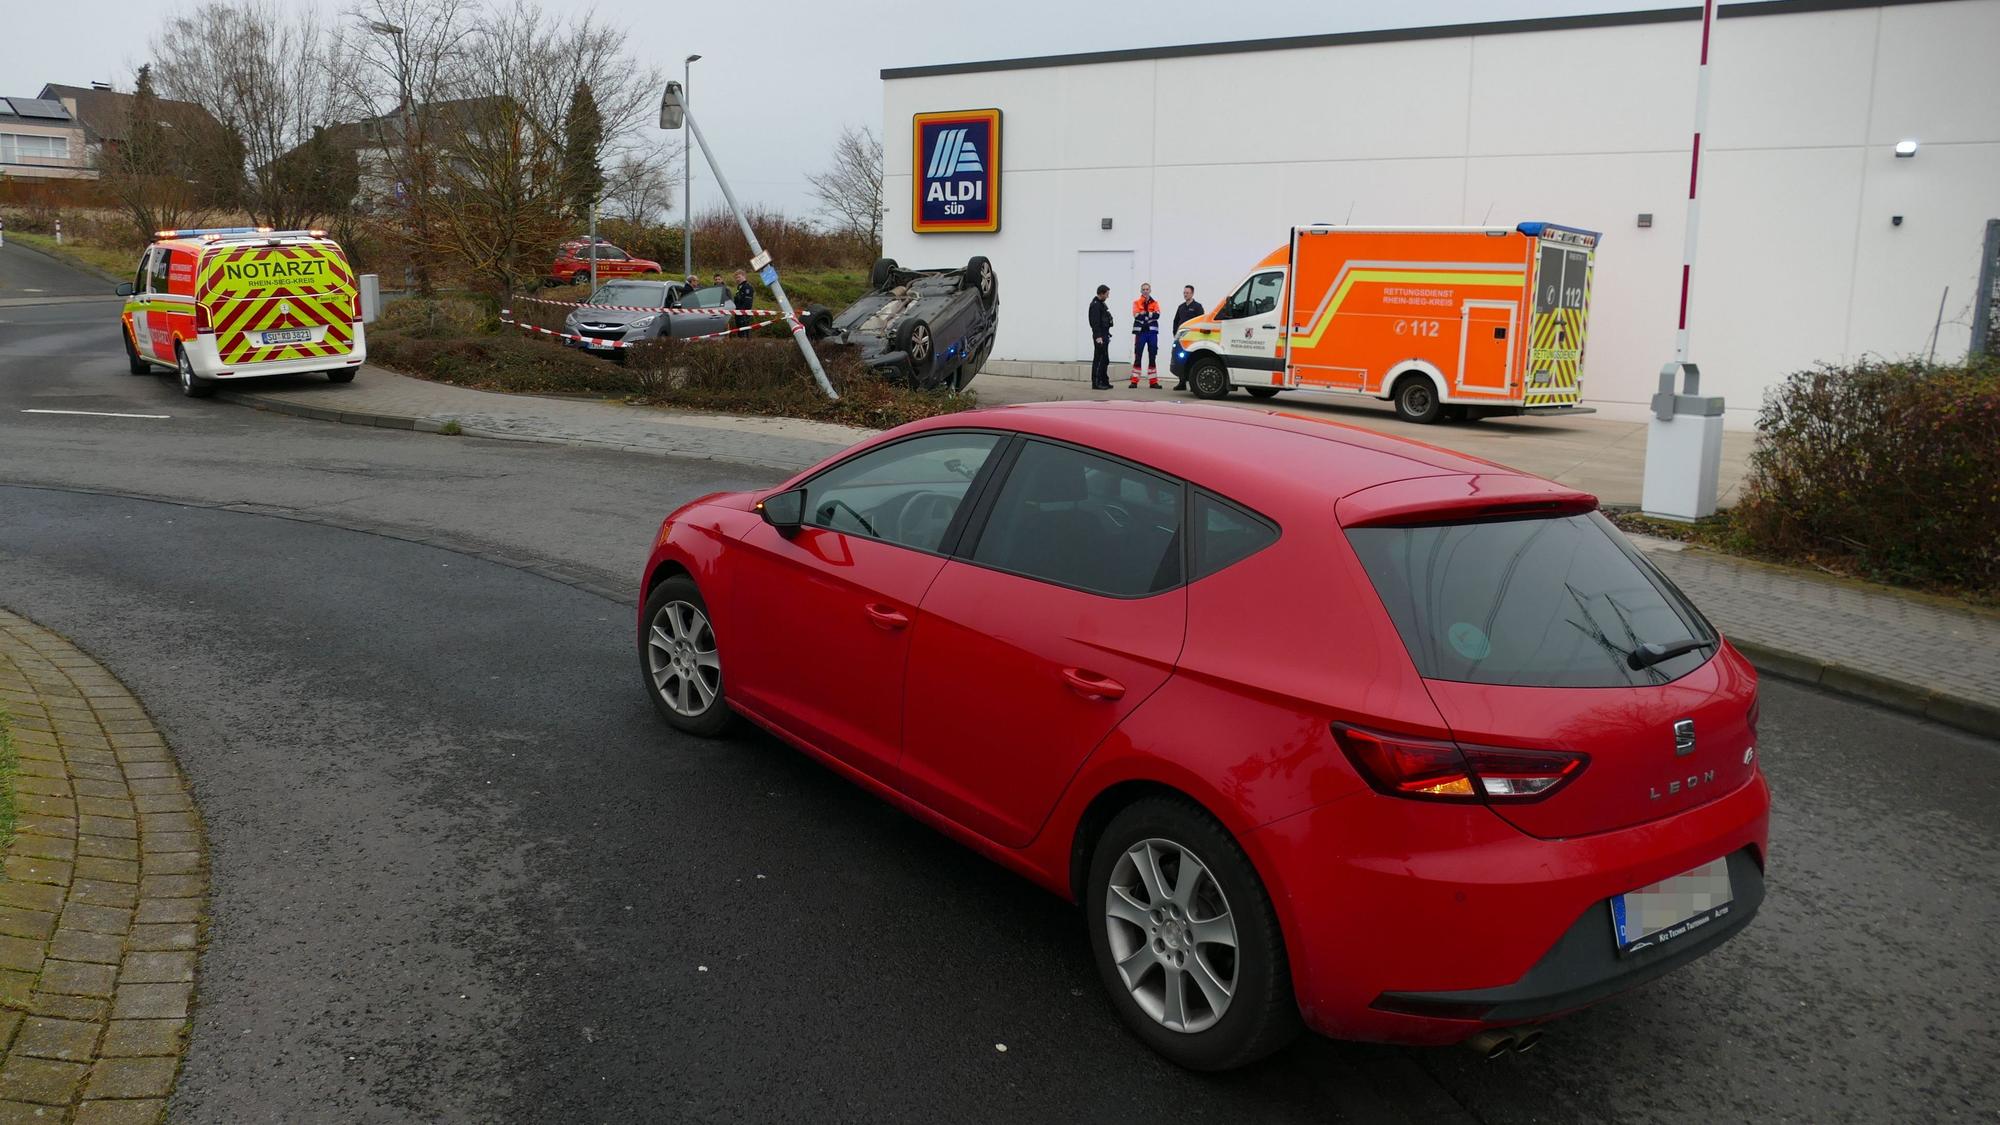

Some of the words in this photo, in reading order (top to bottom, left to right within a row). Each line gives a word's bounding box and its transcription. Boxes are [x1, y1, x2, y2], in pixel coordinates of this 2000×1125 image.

[926, 180, 983, 202] ALDI
[944, 202, 965, 215] SÜD
[226, 260, 325, 280] NOTARZT
[248, 278, 315, 287] RHEIN-SIEG-KREIS
[1383, 287, 1454, 297] RETTUNGSDIENST
[1566, 287, 1581, 307] 112
[1382, 296, 1453, 306] RHEIN-SIEG-KREIS
[1411, 320, 1440, 337] 112
[1650, 769, 1715, 800] LEON
